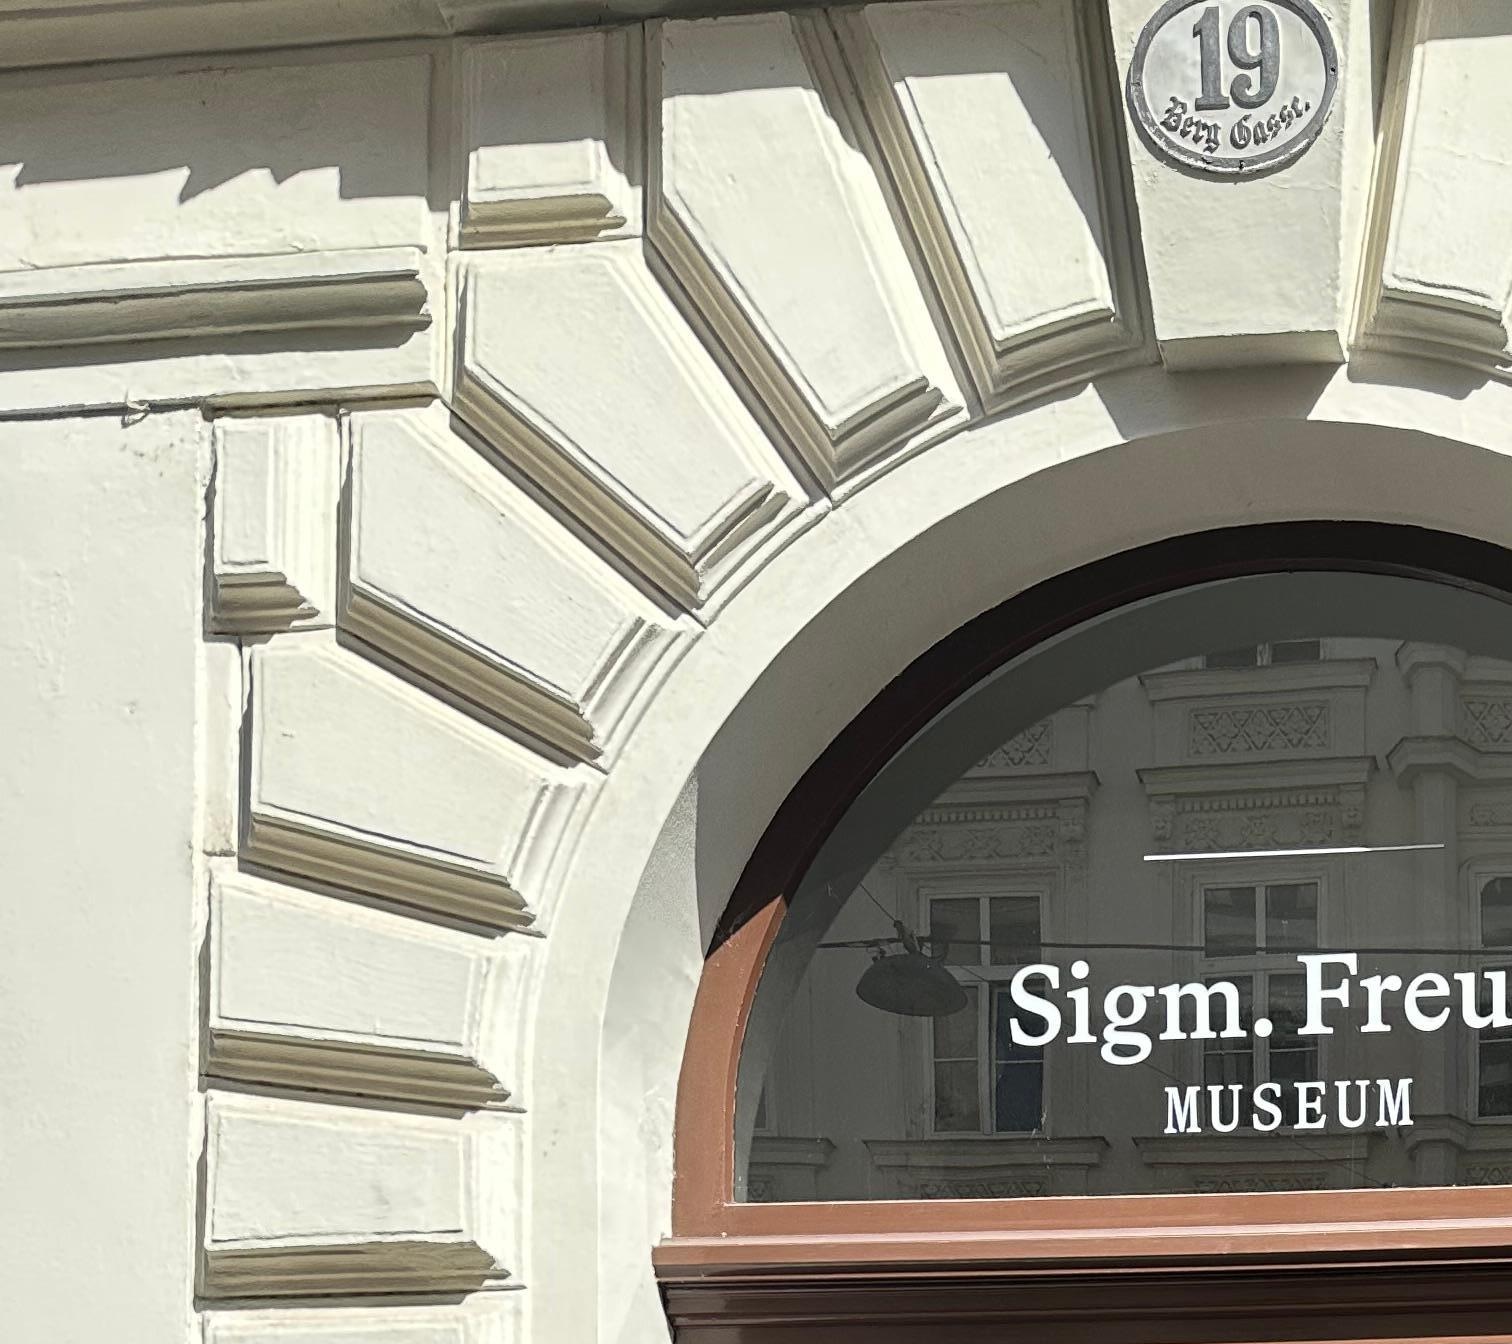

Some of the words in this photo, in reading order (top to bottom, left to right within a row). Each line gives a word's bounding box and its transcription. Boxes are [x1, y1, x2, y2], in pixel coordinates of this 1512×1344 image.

[1193, 5, 1281, 111] 19
[1160, 96, 1221, 154] Berg
[1009, 960, 1274, 1066] Sigm.
[1163, 1077, 1415, 1135] MUSEUM
